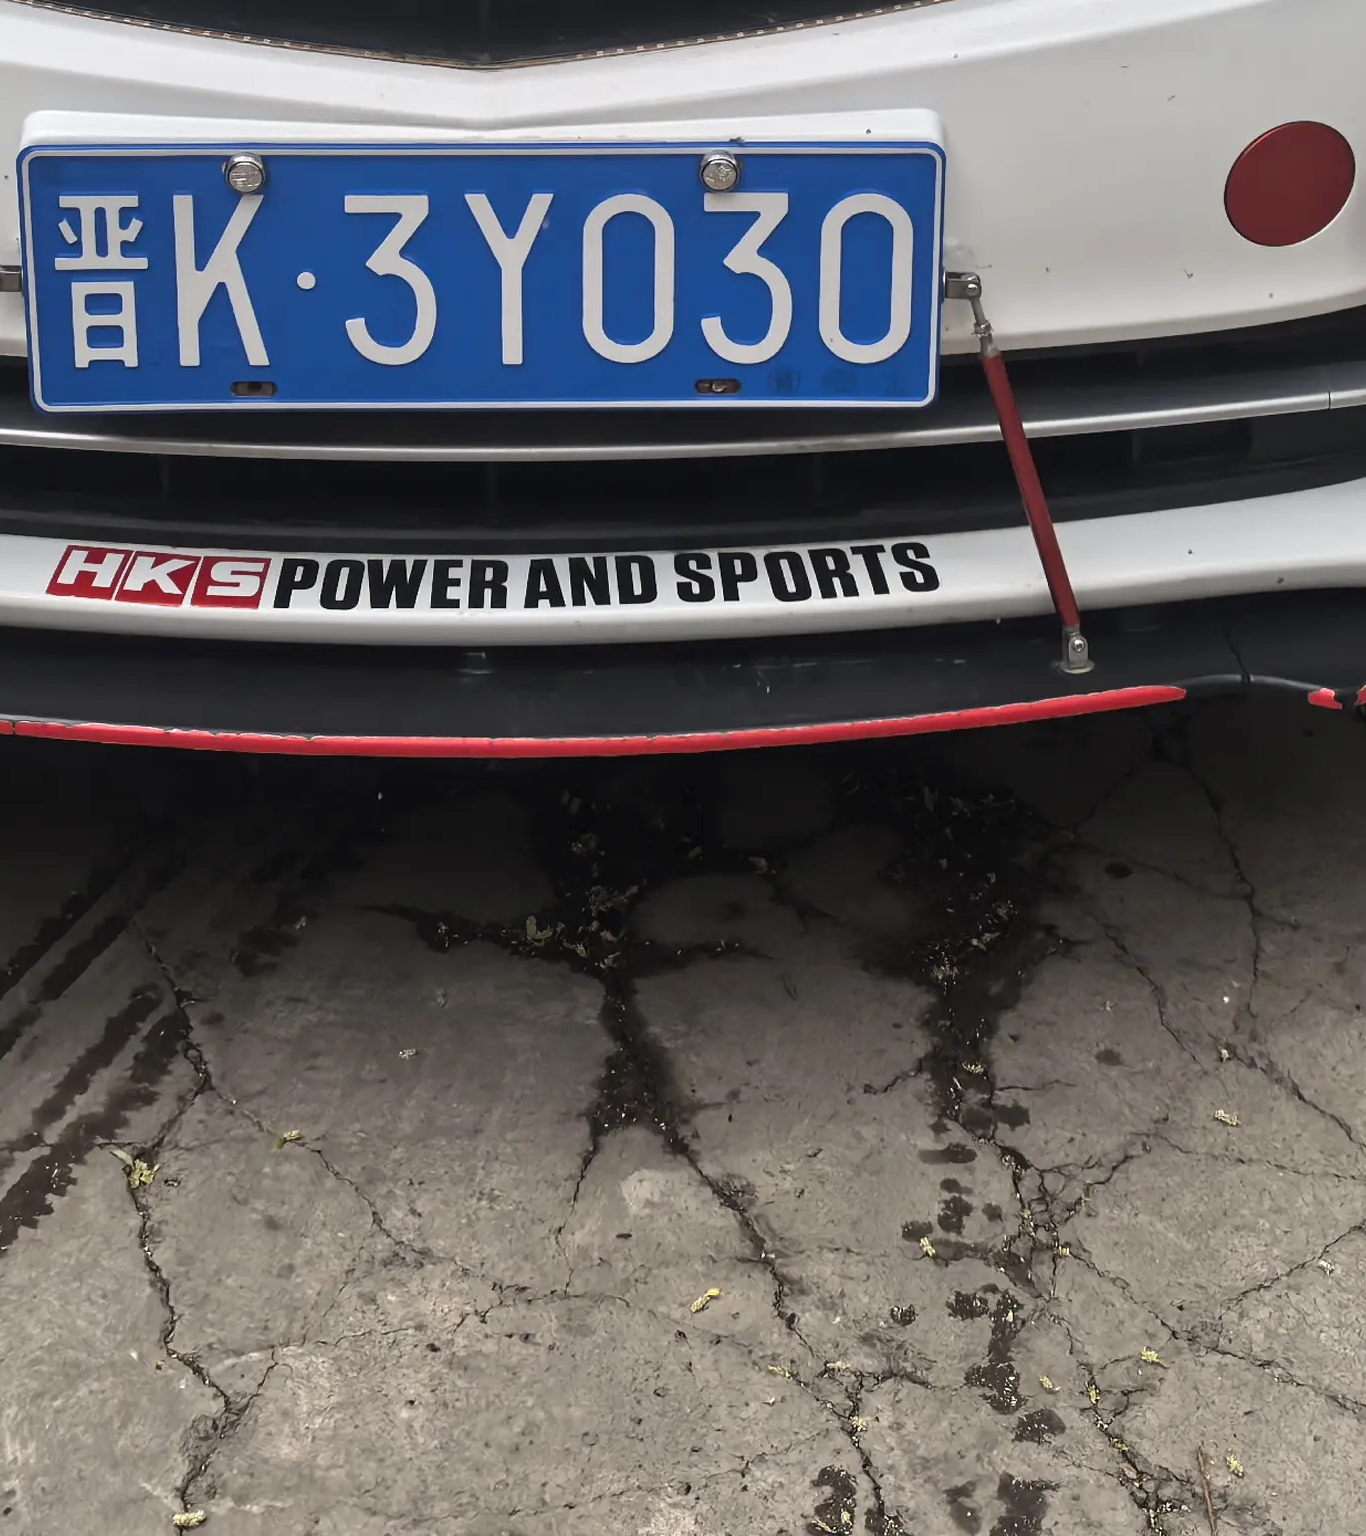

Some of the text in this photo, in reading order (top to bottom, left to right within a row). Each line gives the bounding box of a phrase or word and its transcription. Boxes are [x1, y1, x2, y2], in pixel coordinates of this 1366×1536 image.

[51, 542, 940, 611] HKS POWER AND SPORTS
